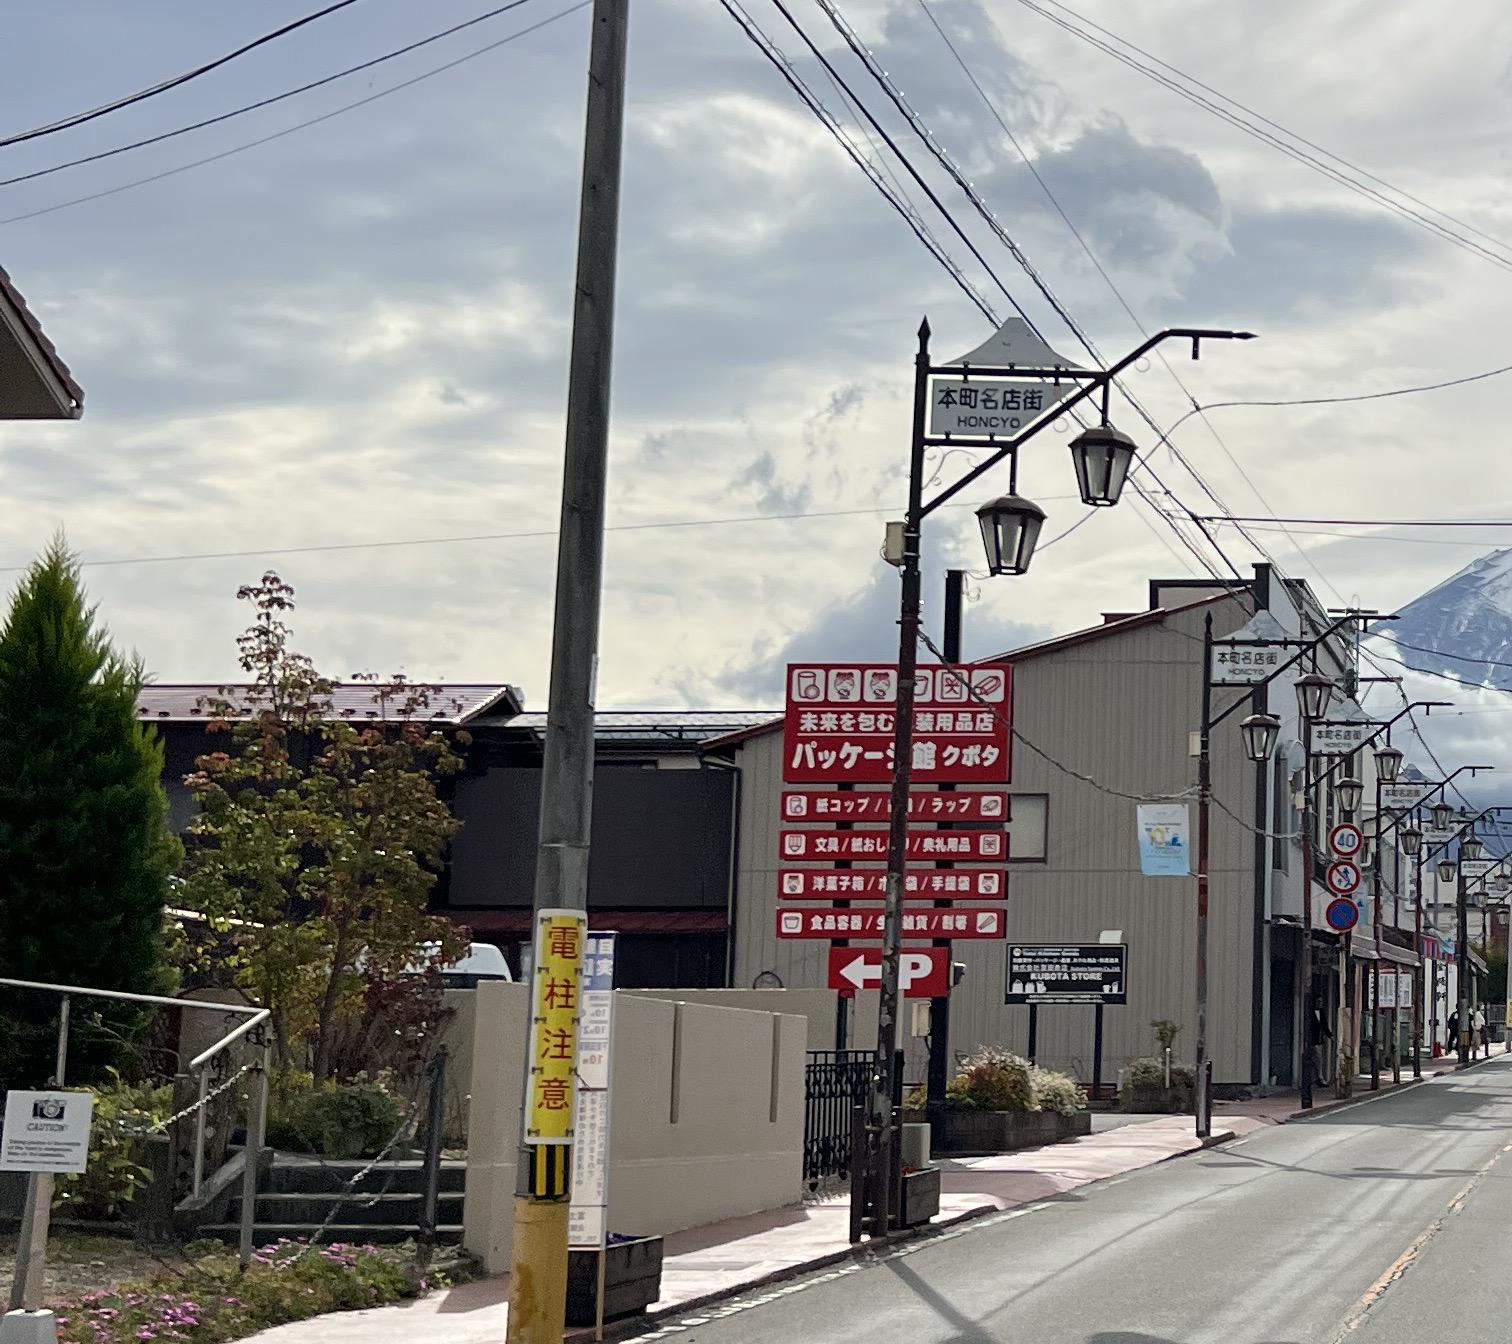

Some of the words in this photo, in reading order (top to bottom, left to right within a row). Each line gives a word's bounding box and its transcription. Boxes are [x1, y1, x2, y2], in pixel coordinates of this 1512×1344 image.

[938, 386, 1044, 411] 本町名店街
[957, 415, 1021, 429] HONCYO
[1218, 651, 1277, 665] 本町名店街
[800, 712, 995, 732] 未来を包む装用品店
[1337, 833, 1356, 848] 40
[898, 953, 933, 990] P
[1030, 972, 1070, 980] KUBOTA
[1071, 972, 1103, 981] STORE
[538, 926, 579, 1111] 電柱注意
